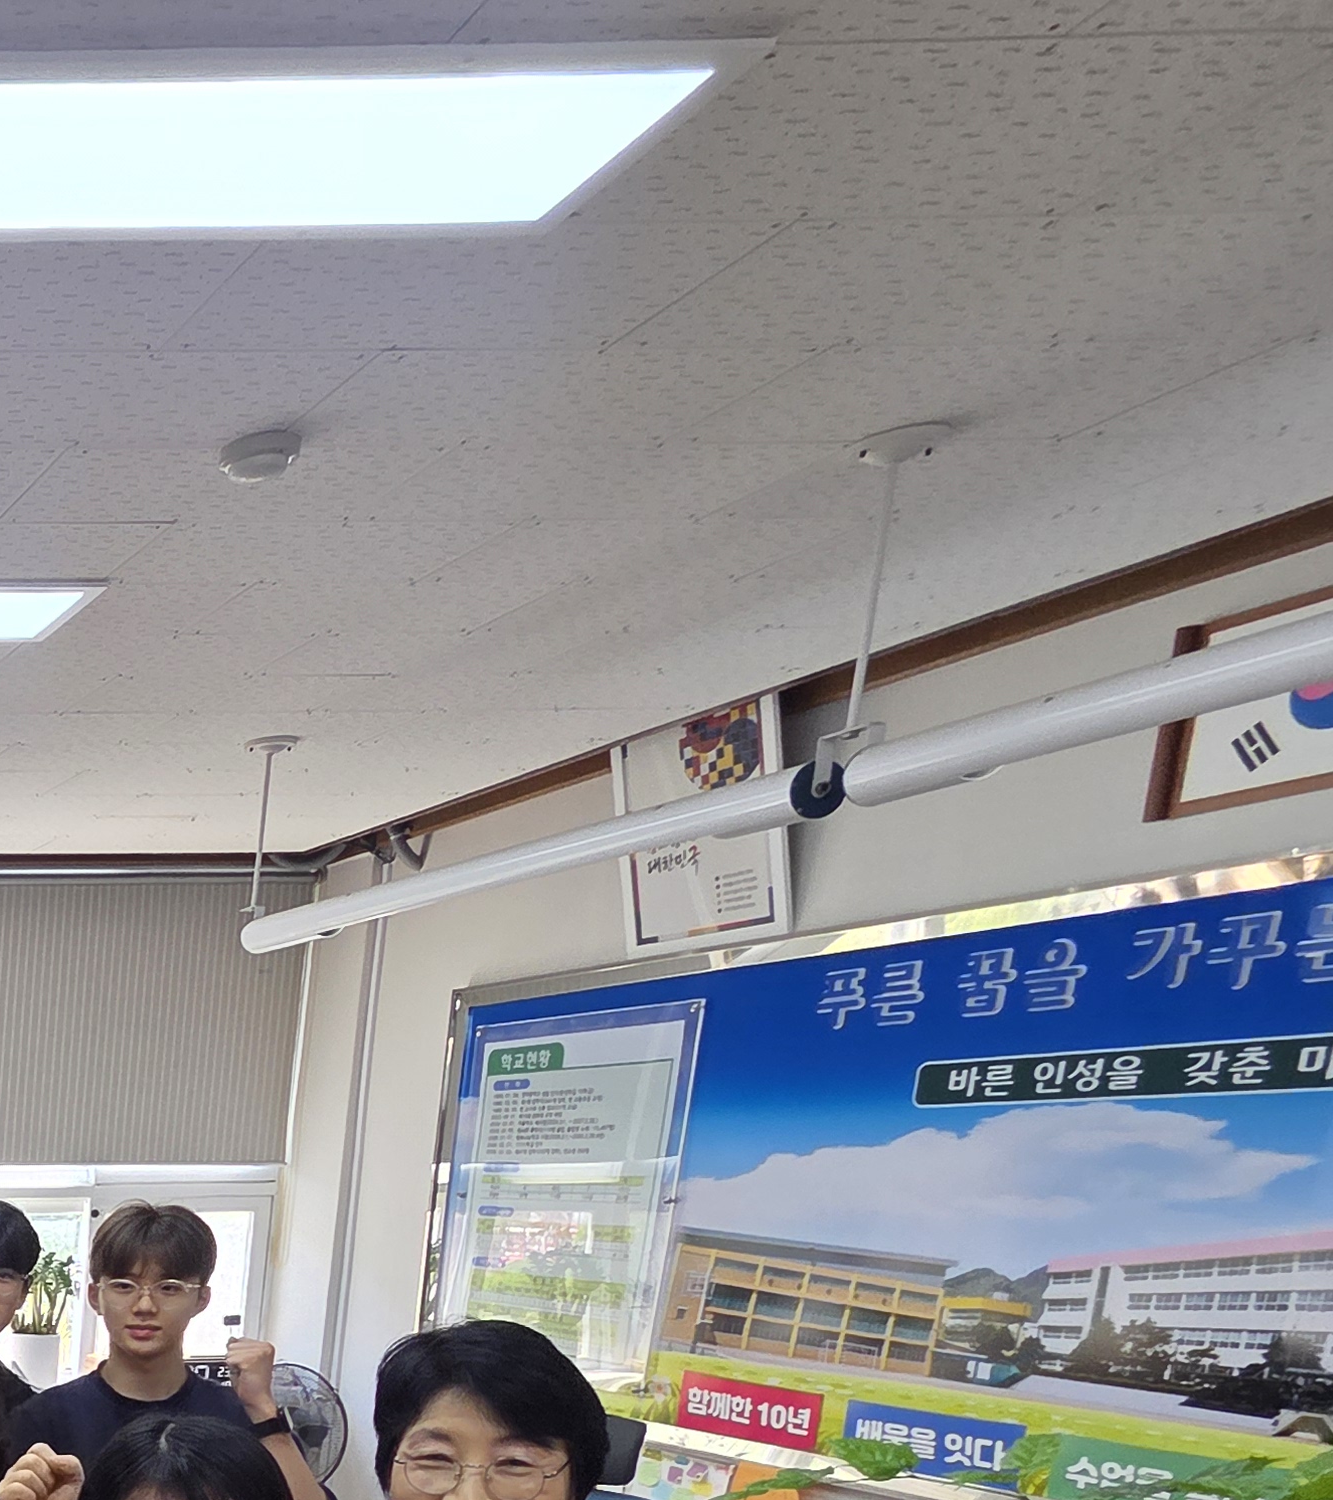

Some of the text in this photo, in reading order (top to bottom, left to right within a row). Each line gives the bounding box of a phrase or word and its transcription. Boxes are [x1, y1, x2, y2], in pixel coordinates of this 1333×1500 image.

[817, 959, 925, 1030] 푸른
[957, 938, 1088, 1019] 꿈을
[501, 1049, 551, 1071] 학교현황
[947, 1065, 1015, 1098] 바른
[1033, 1054, 1144, 1093] 인성을
[1182, 1046, 1271, 1087] 갖춘
[687, 1386, 812, 1437] 함께한 10년
[944, 1432, 1008, 1472] 잇다
